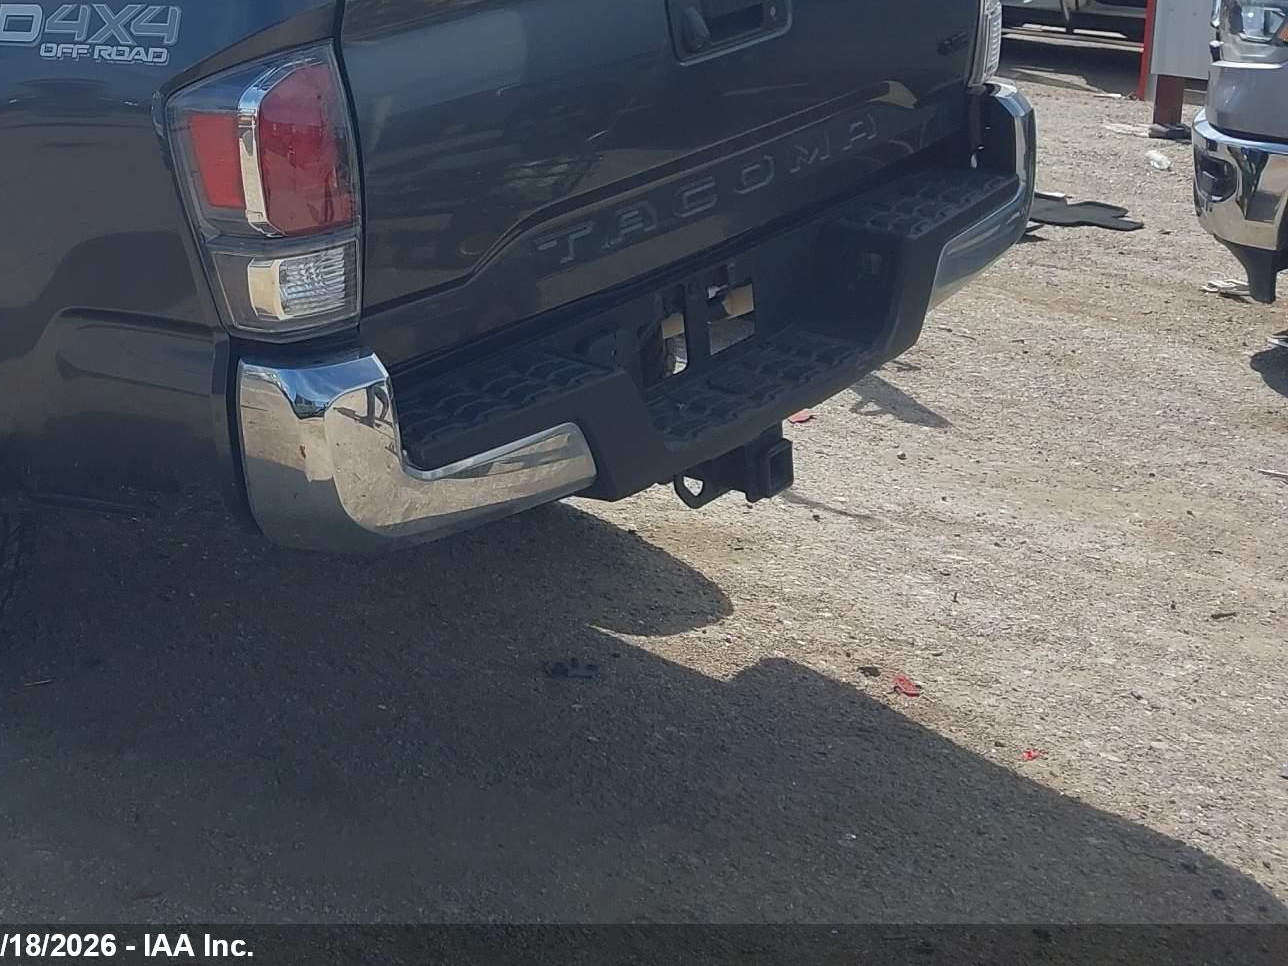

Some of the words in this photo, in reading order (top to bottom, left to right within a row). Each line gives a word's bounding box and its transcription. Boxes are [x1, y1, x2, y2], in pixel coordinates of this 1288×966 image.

[39, 43, 90, 62] OFF
[92, 45, 170, 67] ROAD
[534, 114, 881, 265] TACOMA
